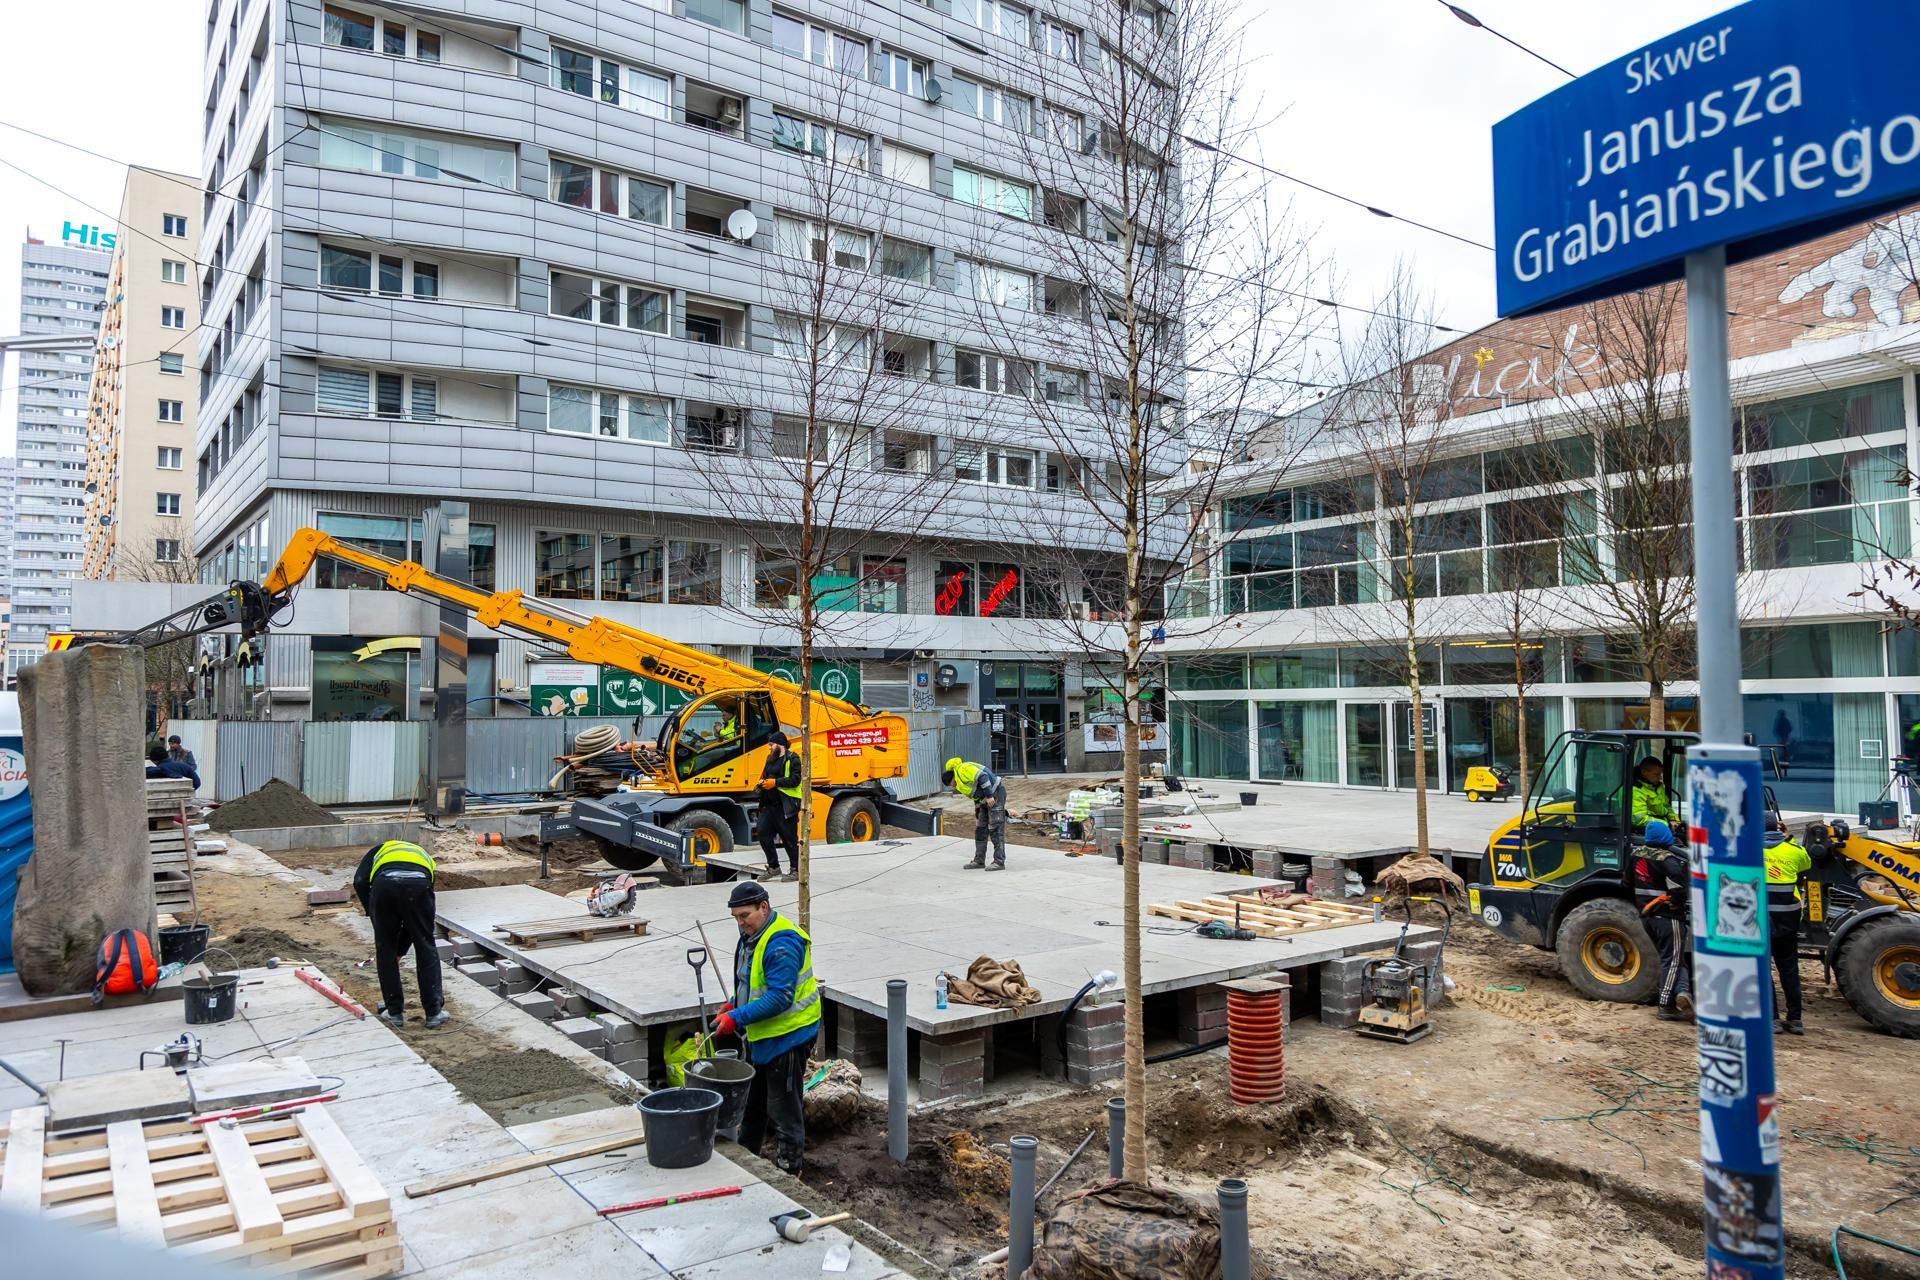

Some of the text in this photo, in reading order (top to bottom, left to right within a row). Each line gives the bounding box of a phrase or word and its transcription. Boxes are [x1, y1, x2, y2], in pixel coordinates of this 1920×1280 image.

[1625, 26, 1733, 94] Skwer
[1577, 64, 1802, 187] Janusza
[1513, 114, 1920, 283] Grabiańskiego
[1498, 853, 1512, 863] WA
[1485, 911, 1499, 922] 20
